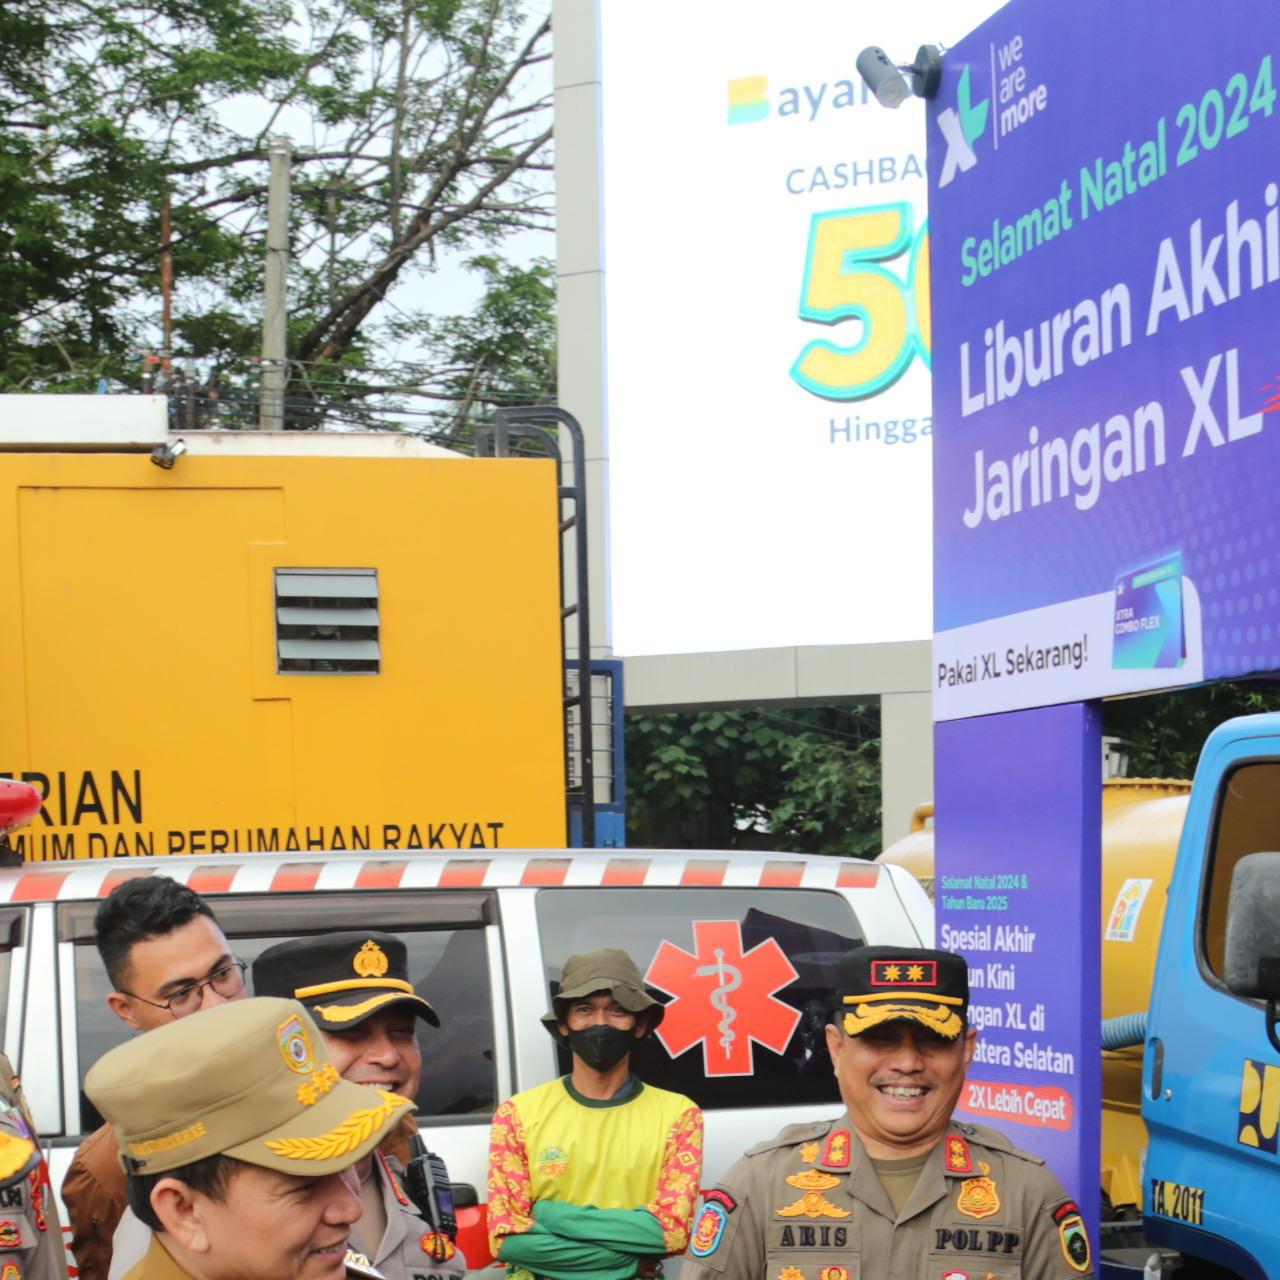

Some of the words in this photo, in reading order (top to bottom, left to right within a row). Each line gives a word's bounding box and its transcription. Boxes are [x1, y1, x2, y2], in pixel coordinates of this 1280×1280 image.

[998, 35, 1023, 62] we
[999, 66, 1026, 96] are
[1001, 83, 1047, 136] more
[786, 153, 928, 194] CASHBA
[961, 179, 1072, 287] Selamat
[1080, 117, 1167, 220] Natal
[1176, 54, 1276, 167] 2024
[960, 282, 1131, 417] Liburan
[830, 416, 932, 445] Hingga
[963, 398, 1166, 529] Jaringan
[1180, 347, 1263, 458] XL
[1140, 616, 1160, 630] FLEX
[938, 656, 977, 688] Pakai
[981, 652, 1001, 680] XL
[1006, 633, 1088, 675] Sekarang!
[88, 831, 155, 858] DAN
[383, 822, 504, 850] RAKYAT
[942, 875, 972, 890] Selamat
[974, 874, 996, 890] Natal
[997, 874, 1019, 890] 2024
[942, 896, 965, 910] Tahun
[966, 896, 985, 910] Baru
[986, 896, 1008, 910] 2025
[941, 924, 991, 954] Spesial
[993, 925, 1036, 952] Akhir
[987, 963, 1015, 990] Kini
[1005, 1002, 1026, 1030] XL
[1029, 1004, 1045, 1031] di
[973, 1038, 1011, 1066] atera
[1014, 1041, 1074, 1075] Selatan
[968, 1084, 986, 1109] 2X
[987, 1086, 1022, 1114] Lebih
[1024, 1091, 1066, 1122] Cepat
[1151, 1178, 1169, 1217] TA.
[1172, 1180, 1206, 1225] 2011
[780, 1224, 848, 1247] ARIS
[935, 1228, 982, 1251] POL
[986, 1230, 1020, 1254] PP
